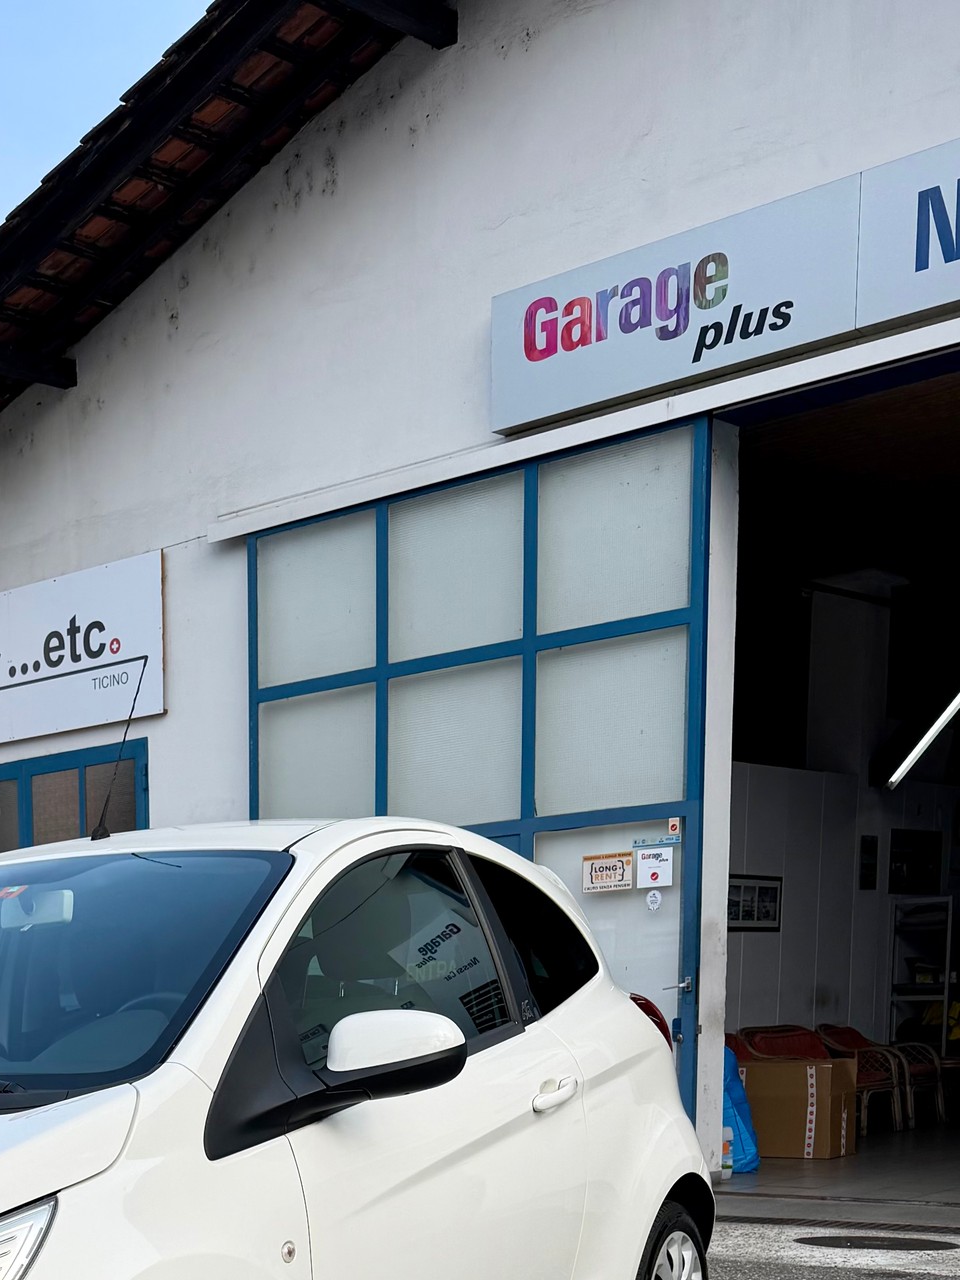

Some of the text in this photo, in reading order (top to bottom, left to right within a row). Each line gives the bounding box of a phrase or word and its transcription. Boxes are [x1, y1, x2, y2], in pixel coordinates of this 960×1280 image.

[522, 251, 729, 363] Garage
[692, 299, 794, 364] plus
[91, 671, 129, 692] TICINO
[594, 864, 618, 873] LONG
[594, 872, 618, 881] RENT
